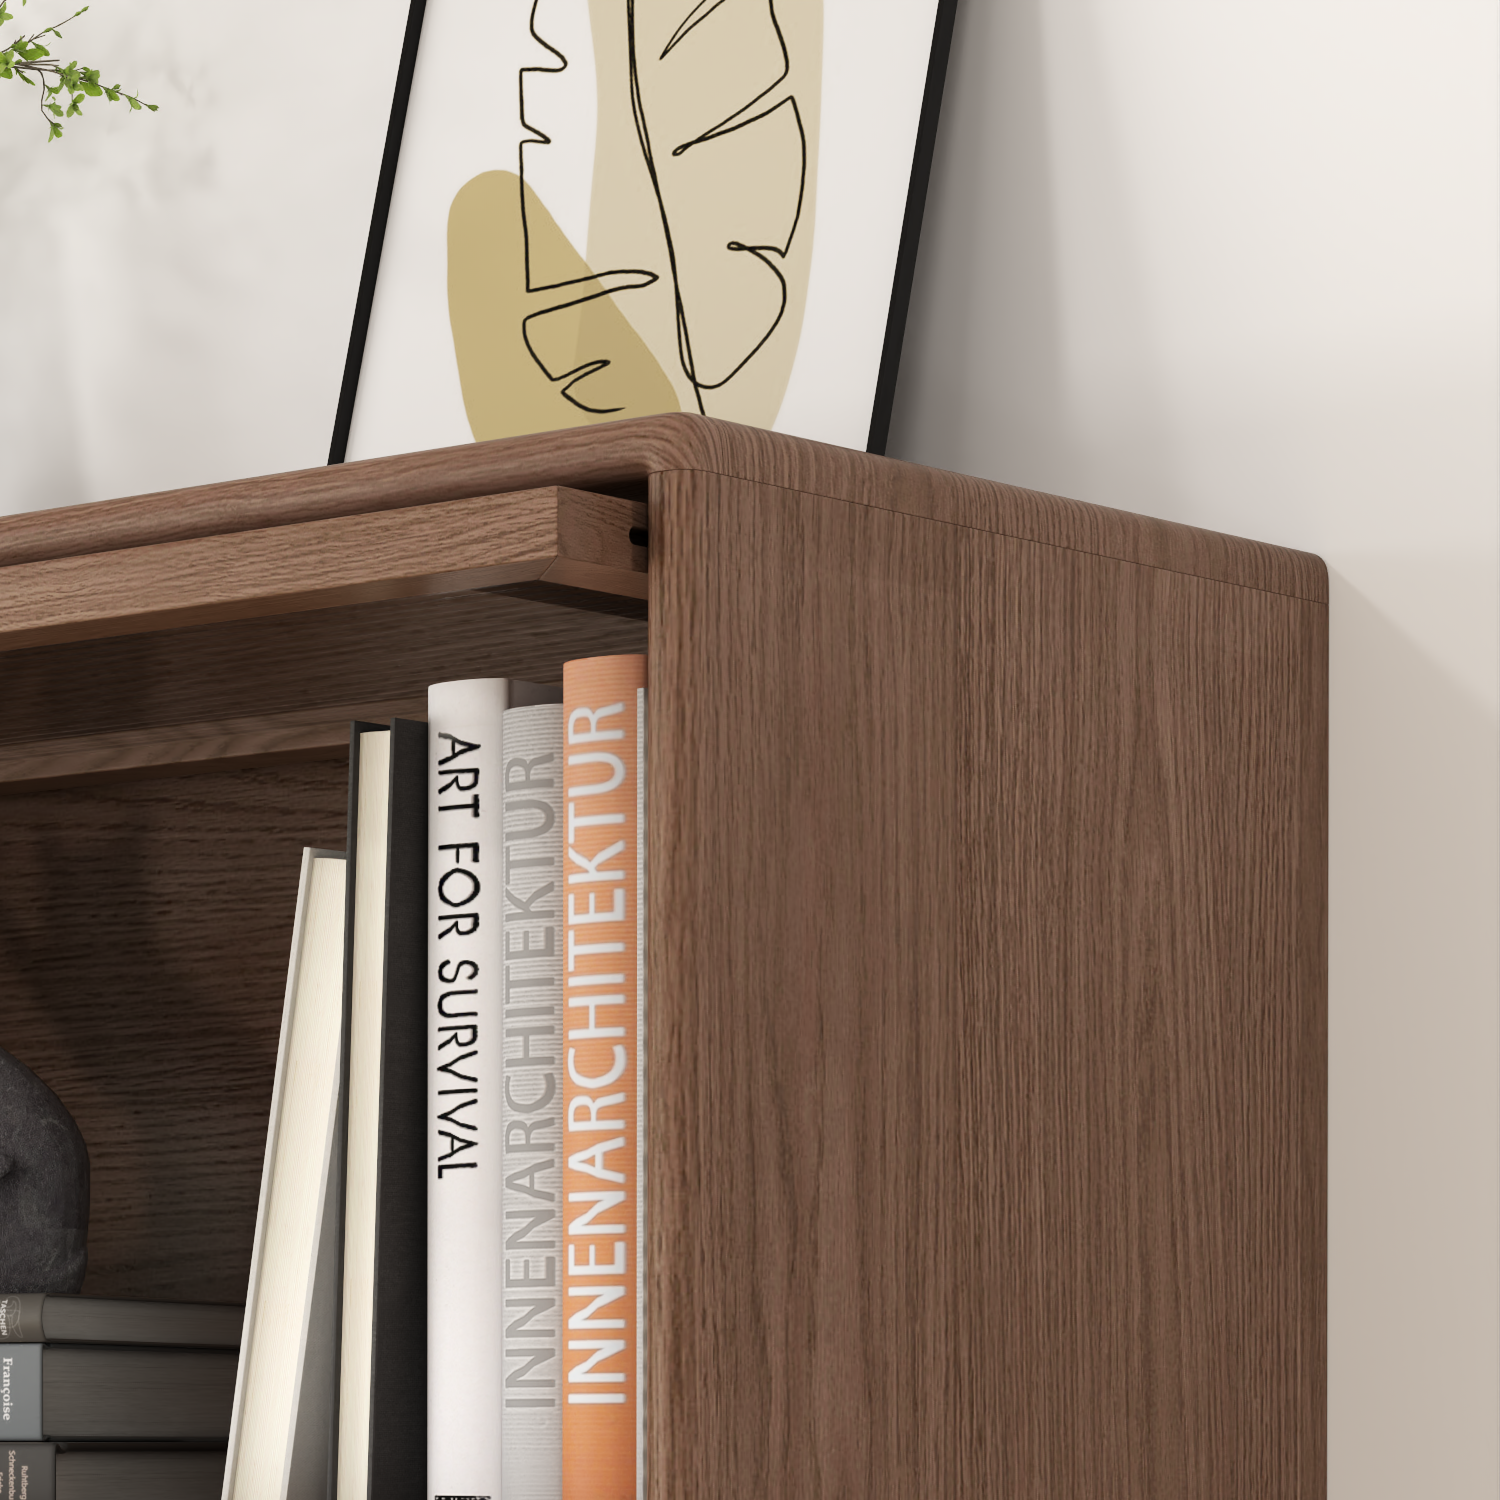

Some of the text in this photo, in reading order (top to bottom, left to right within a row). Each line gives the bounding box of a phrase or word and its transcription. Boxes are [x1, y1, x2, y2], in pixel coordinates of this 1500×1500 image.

[436, 731, 482, 1180] ART FOR SURVIVAL
[504, 751, 556, 1408] INNENARCHITEKTUR
[567, 702, 628, 1404] INNENARCHITEKTUR
[0, 1299, 8, 1336] TASCHEN
[0, 1357, 14, 1421] Françoise
